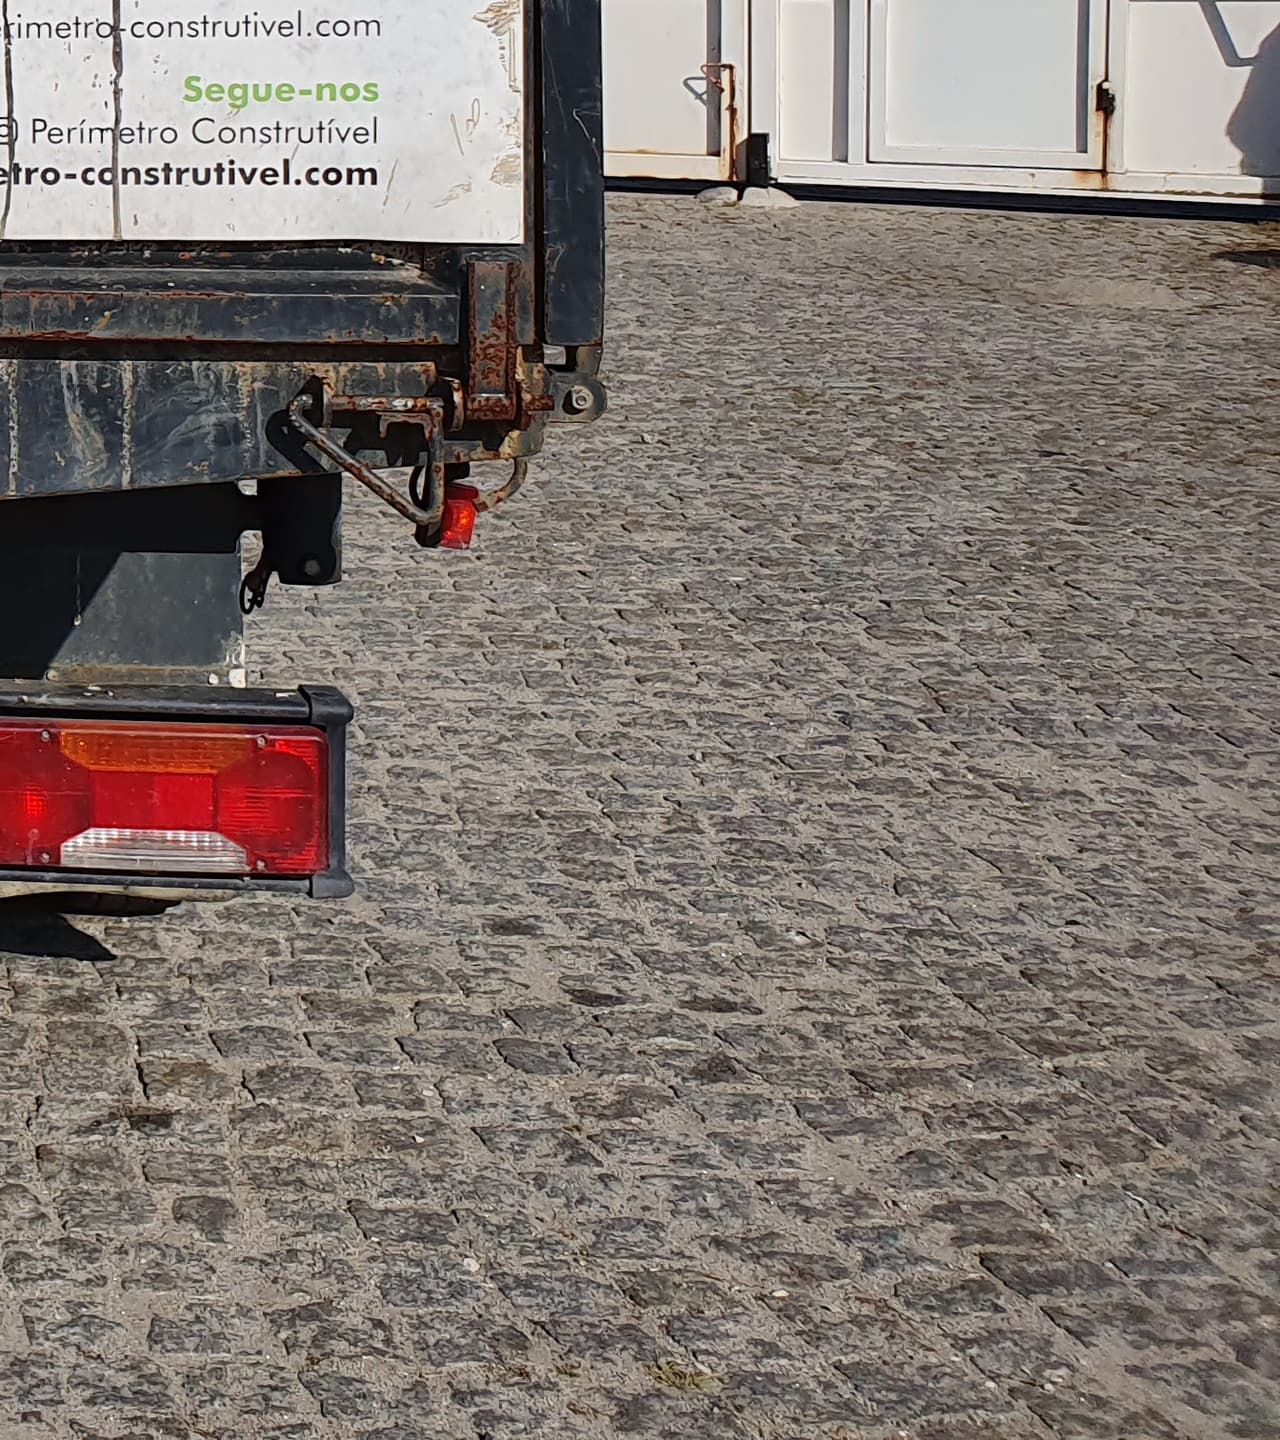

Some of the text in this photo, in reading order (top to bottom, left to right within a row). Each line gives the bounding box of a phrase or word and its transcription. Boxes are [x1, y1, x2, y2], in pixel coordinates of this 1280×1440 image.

[182, 75, 380, 109] Segue-nos
[32, 118, 178, 145] Perímetro
[192, 116, 378, 145] Construtível
